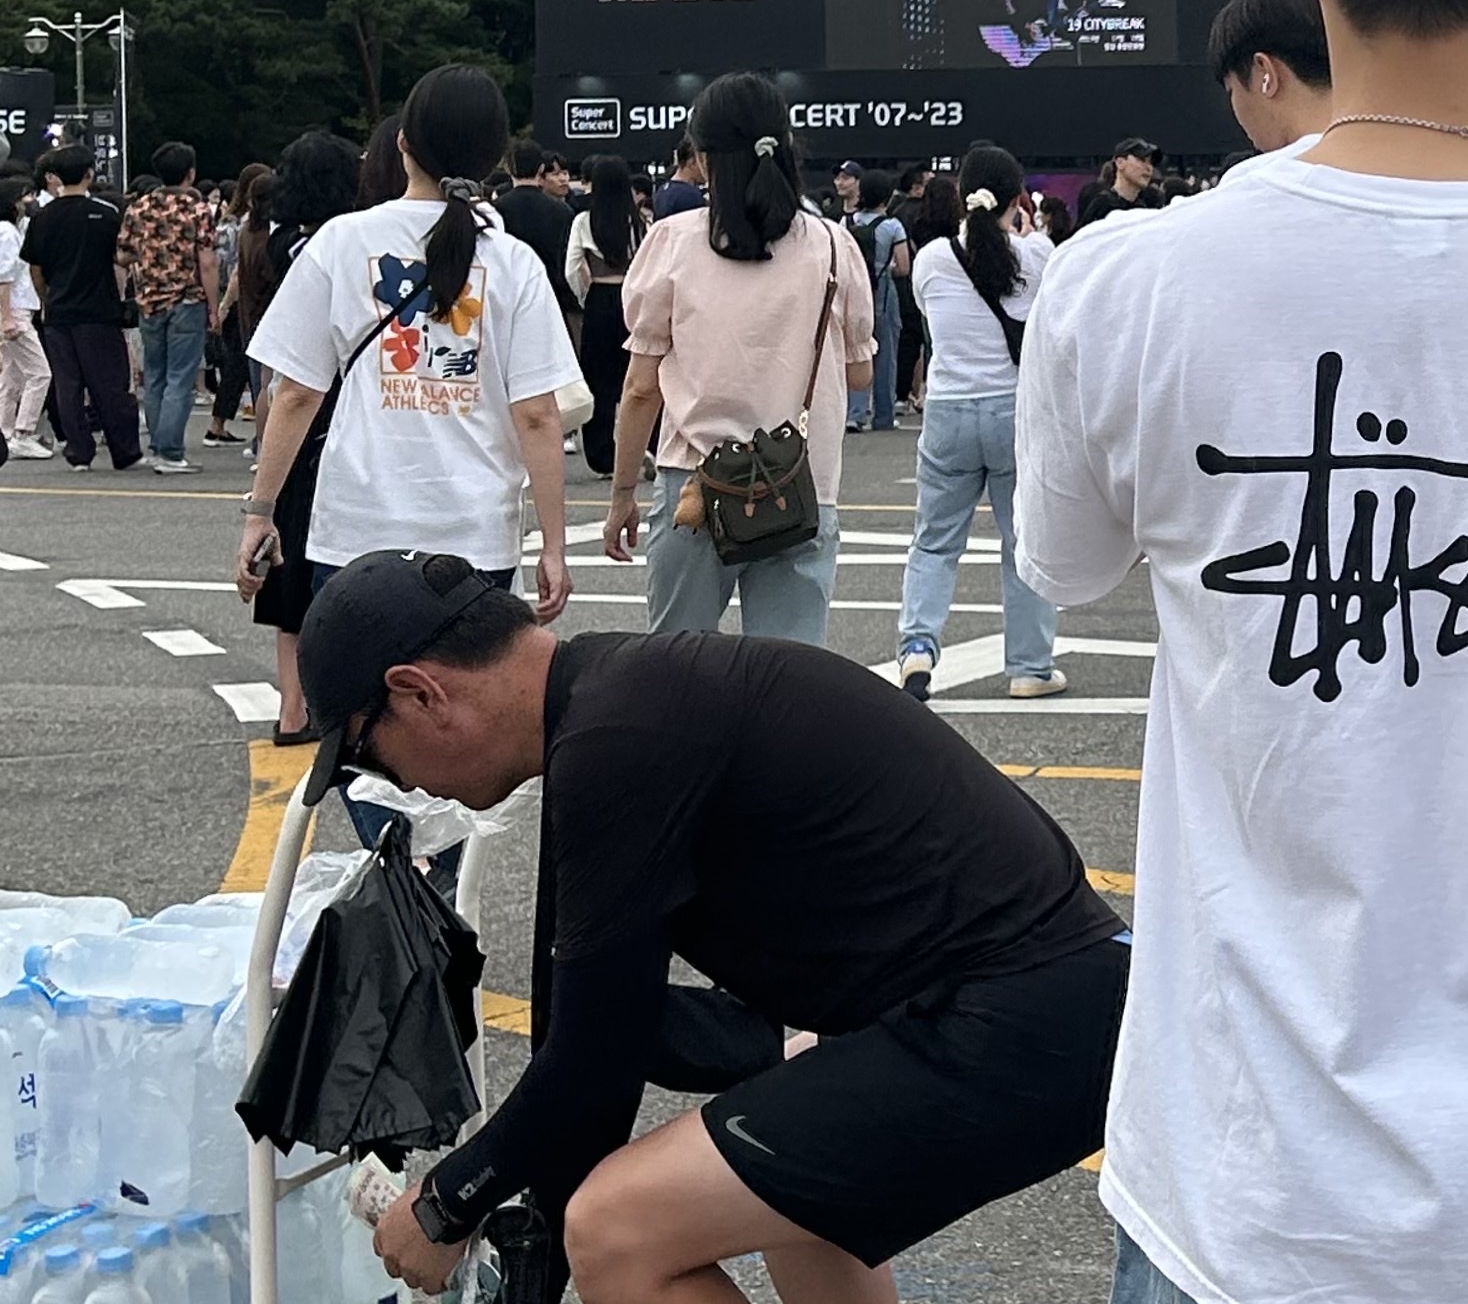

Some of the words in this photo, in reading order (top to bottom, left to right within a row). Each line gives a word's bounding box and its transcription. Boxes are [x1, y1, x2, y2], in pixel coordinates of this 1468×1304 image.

[571, 106, 605, 120] Super
[629, 106, 696, 130] SUP
[789, 103, 861, 128] CERT
[571, 119, 615, 131] Concert
[381, 379, 417, 394] NEW
[381, 395, 449, 415] ATHLECS
